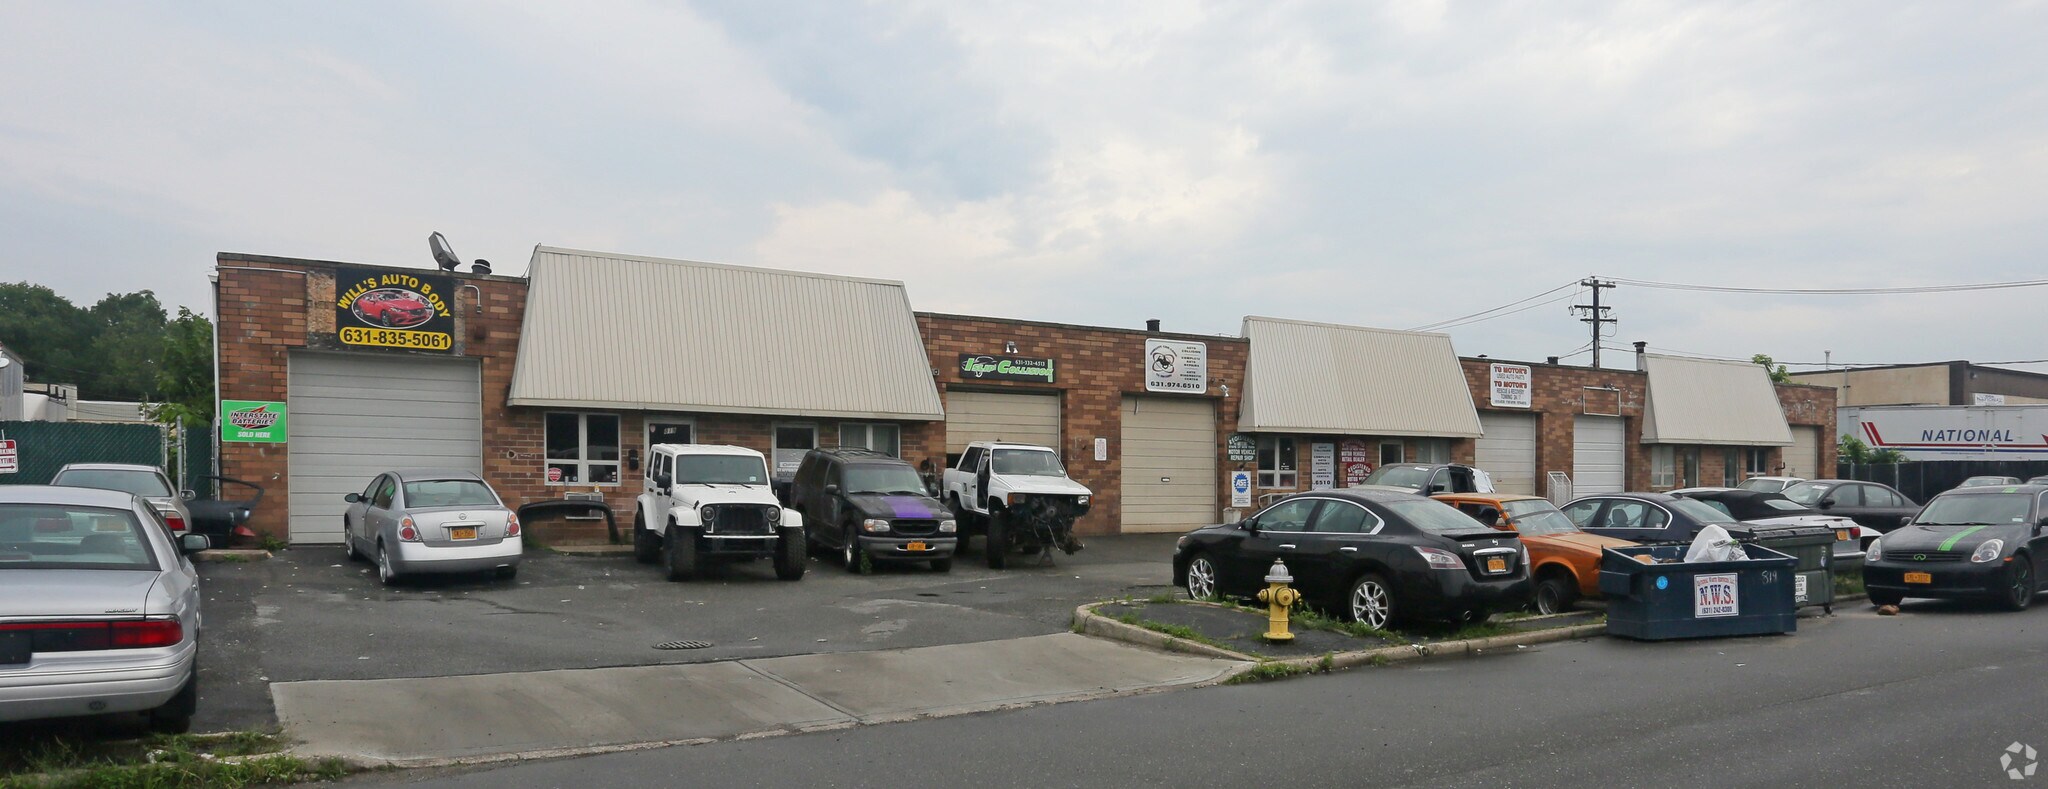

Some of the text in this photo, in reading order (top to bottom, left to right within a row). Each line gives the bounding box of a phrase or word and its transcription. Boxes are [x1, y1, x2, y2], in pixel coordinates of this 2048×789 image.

[337, 274, 451, 318] WILL'S AUTO BODY
[343, 329, 448, 348] 631-835-5061
[964, 357, 1054, 376] ISLIP COLLISION
[1150, 381, 1200, 389] 631.974.6510
[1921, 429, 2014, 442] NATIONAL
[1699, 584, 1734, 605] N.W.S.
